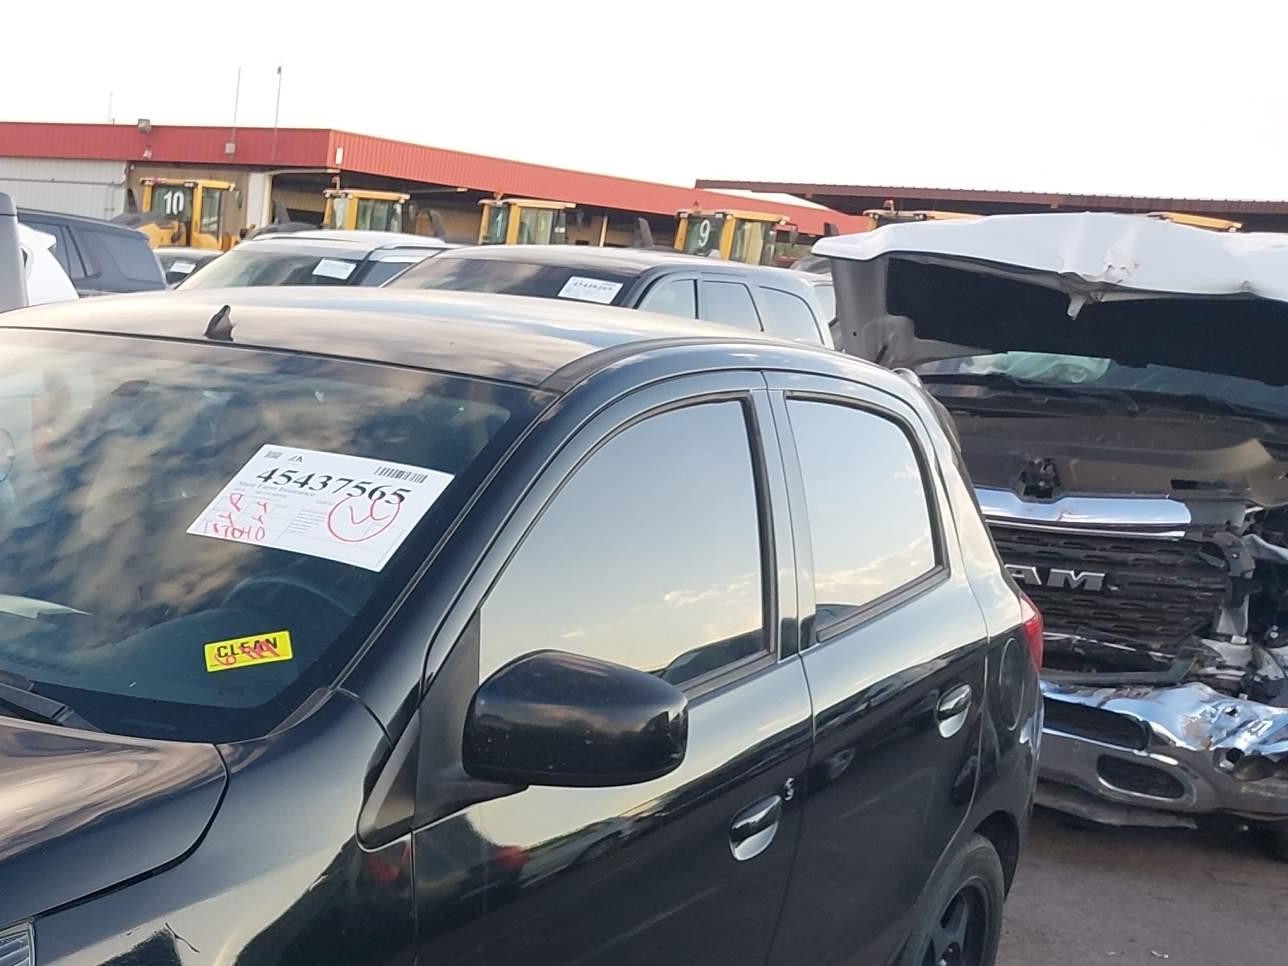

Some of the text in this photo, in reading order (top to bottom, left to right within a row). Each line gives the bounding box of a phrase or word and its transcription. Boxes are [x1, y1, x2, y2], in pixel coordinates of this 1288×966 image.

[163, 190, 184, 215] 10
[698, 219, 711, 247] 9
[255, 467, 411, 505] 45437565
[1004, 563, 1106, 592] AM
[217, 637, 278, 658] CLEAN
